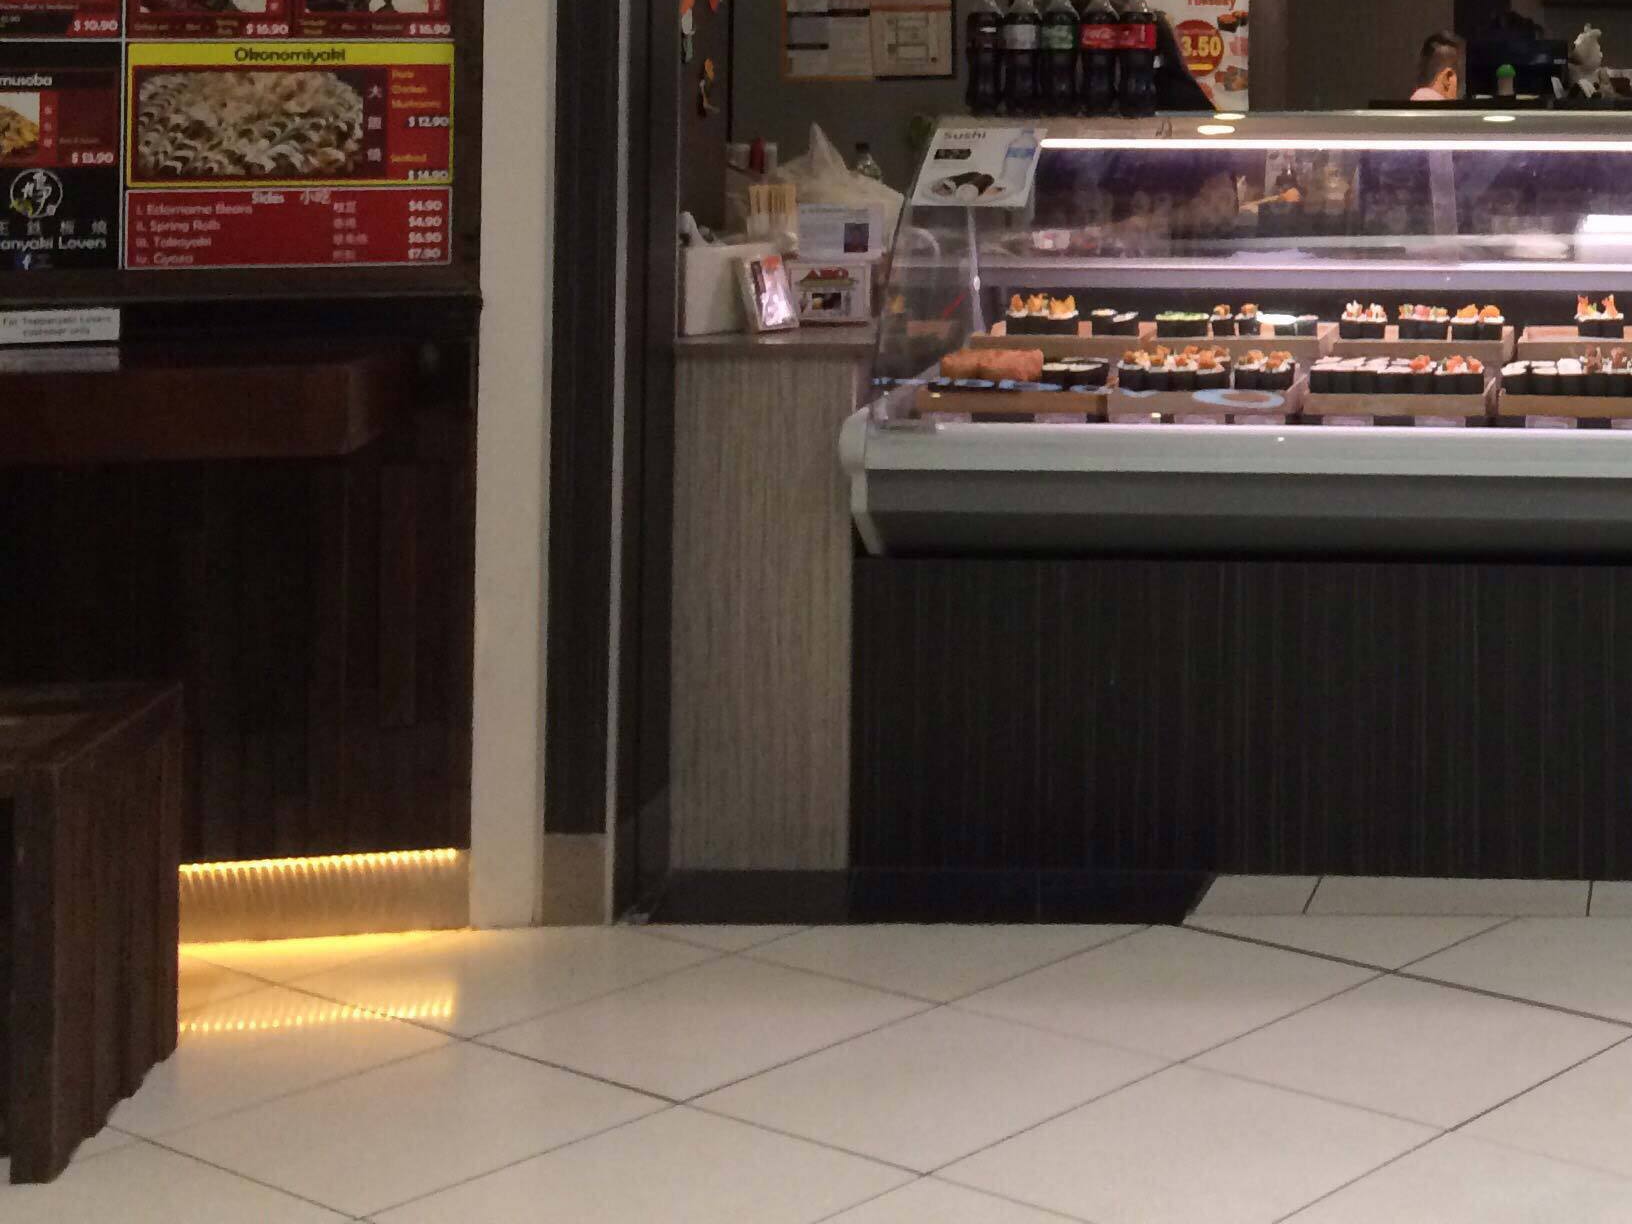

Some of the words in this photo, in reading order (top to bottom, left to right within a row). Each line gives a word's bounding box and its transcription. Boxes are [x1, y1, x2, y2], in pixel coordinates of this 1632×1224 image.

[1181, 35, 1222, 57] 3.50
[234, 46, 345, 63] Okonomiyaki
[943, 131, 987, 140] Sushi
[58, 235, 107, 250] Lovers
